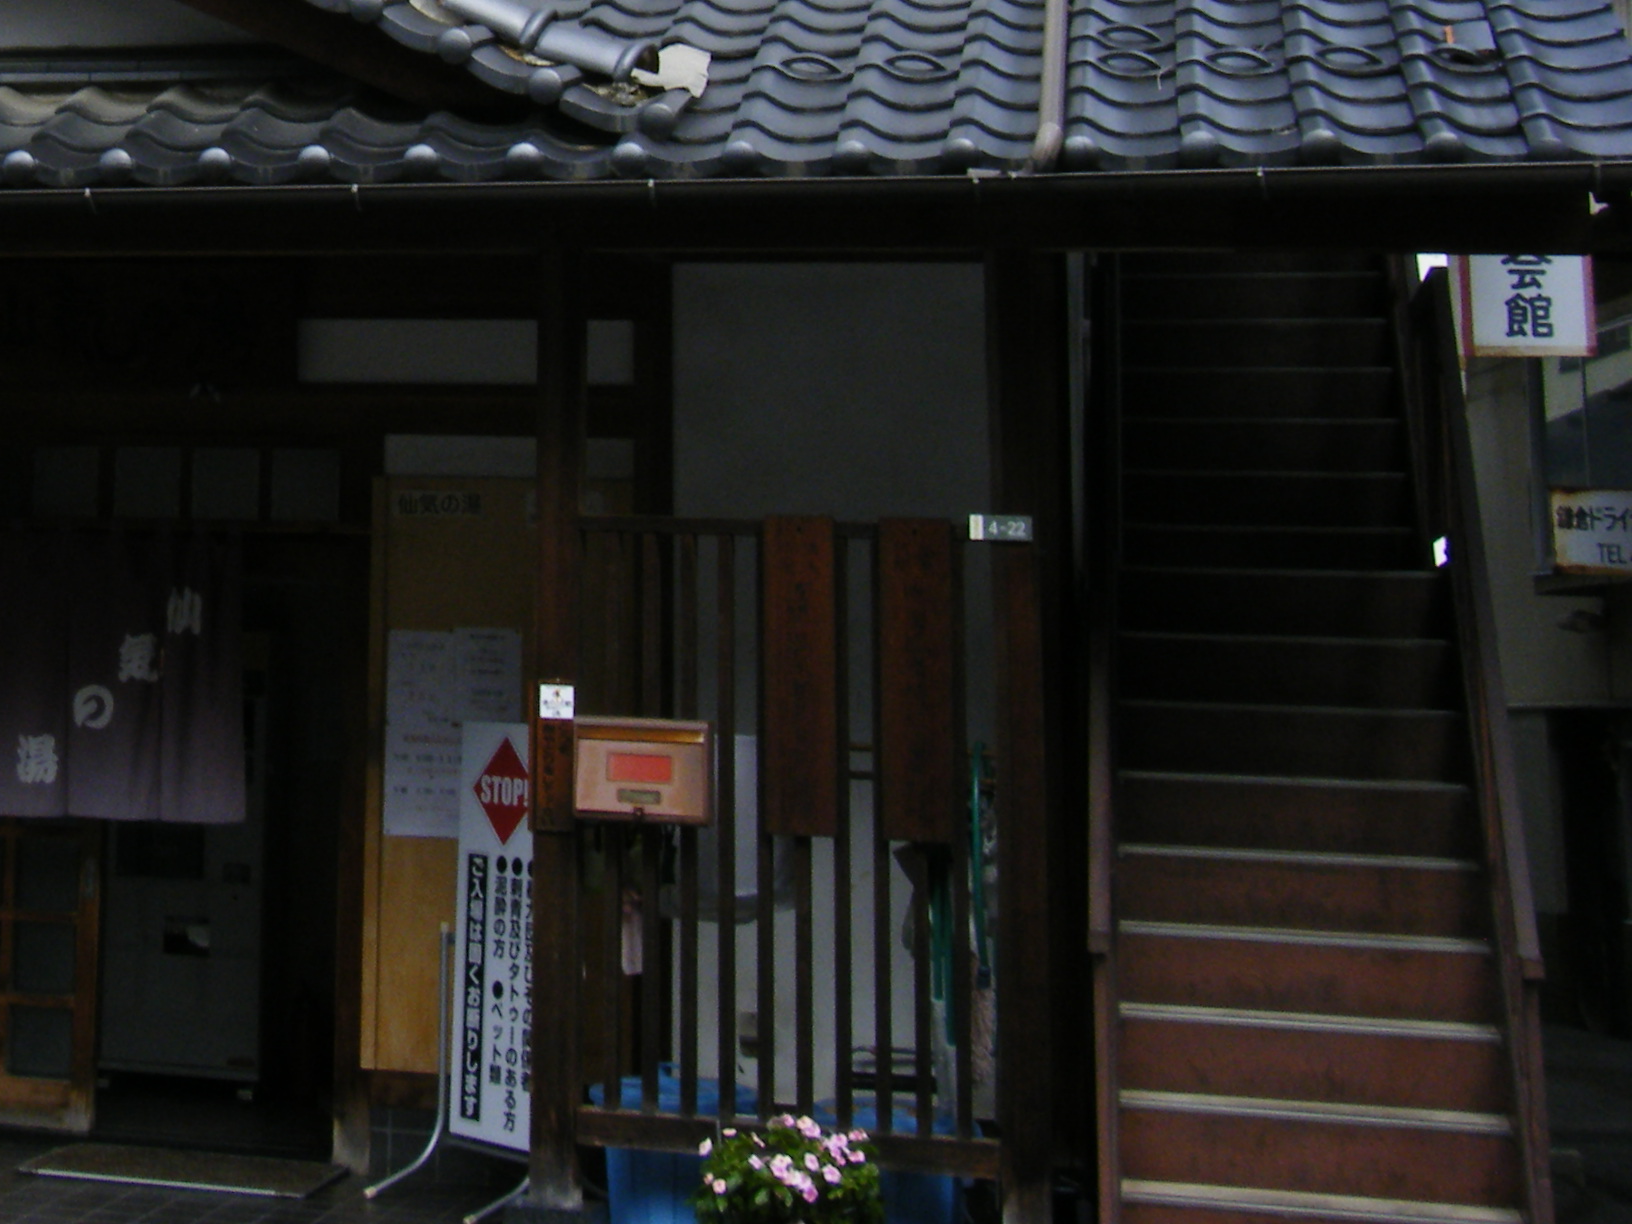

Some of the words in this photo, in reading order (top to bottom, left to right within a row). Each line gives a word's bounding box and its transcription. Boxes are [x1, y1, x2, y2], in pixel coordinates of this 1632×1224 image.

[1500, 254, 1554, 337] 会館
[988, 520, 1026, 537] 4-22
[1596, 542, 1628, 564] TEL
[481, 774, 529, 808] STOP!
